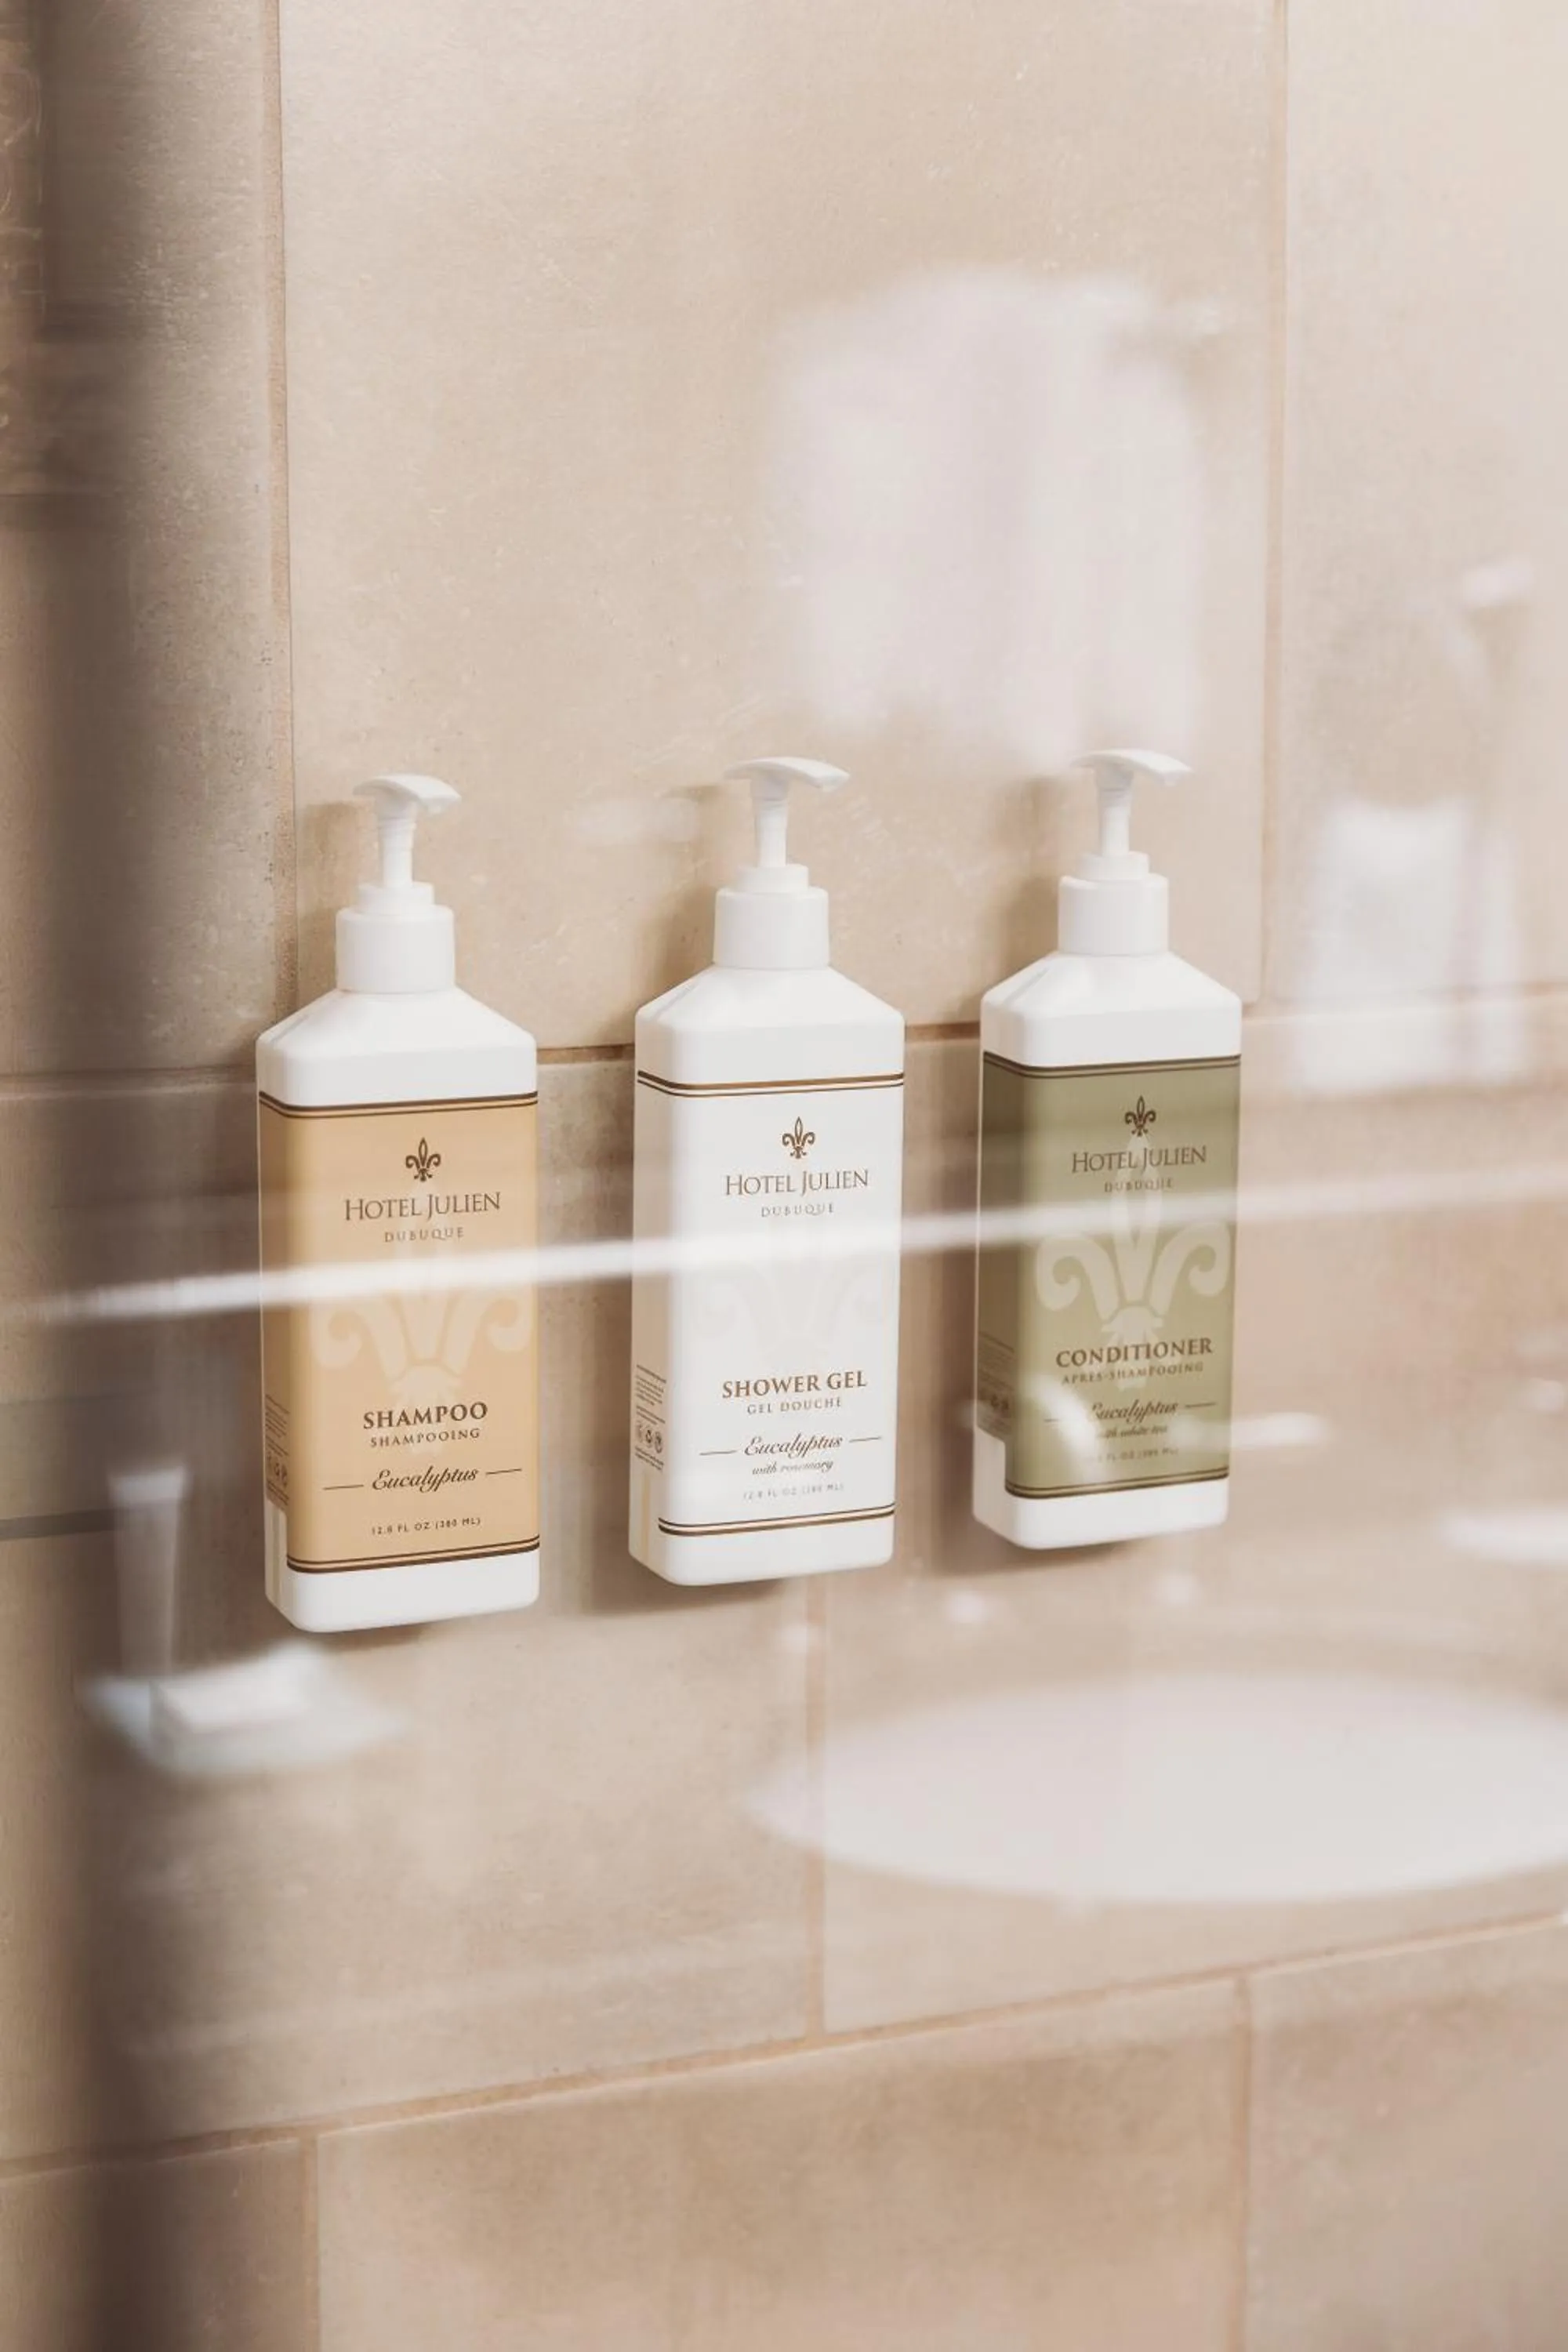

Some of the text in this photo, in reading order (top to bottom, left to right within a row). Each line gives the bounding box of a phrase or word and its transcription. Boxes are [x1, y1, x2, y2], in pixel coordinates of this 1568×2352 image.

[1071, 1145, 1207, 1174] HOTEL JULIEN
[725, 1168, 869, 1197] HOTEL JULIEN
[344, 1191, 501, 1221] HOTEL JULIEN
[760, 1202, 835, 1218] DUBUQUE
[383, 1226, 465, 1243] DUBUQUE
[1055, 1337, 1214, 1368] CONDITIONER
[721, 1370, 869, 1399] SHOWER GEL
[363, 1400, 488, 1430] SHAMPOO
[746, 1396, 843, 1415] GEL DOUCHE
[1091, 1399, 1179, 1425] Eucalyptus
[370, 1427, 481, 1448] SHAMPOOING
[745, 1432, 844, 1460] Eucalyptus
[372, 1465, 480, 1494] Eucalyptus
[751, 1461, 778, 1475] with
[397, 1523, 409, 1534] FL
[413, 1521, 430, 1531] OZ
